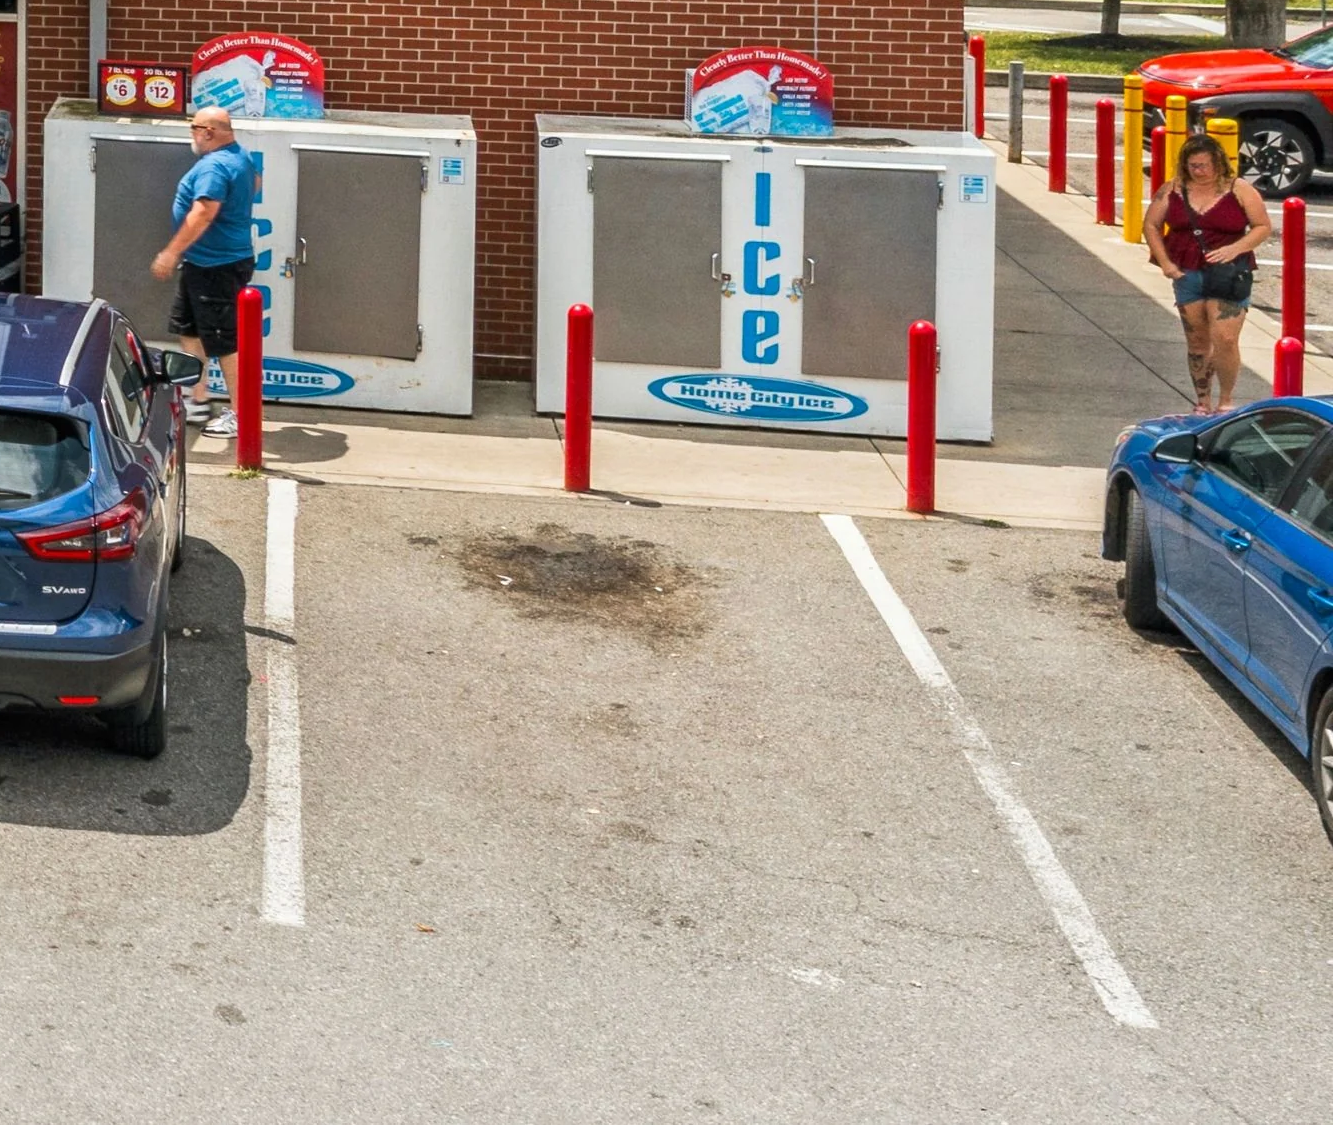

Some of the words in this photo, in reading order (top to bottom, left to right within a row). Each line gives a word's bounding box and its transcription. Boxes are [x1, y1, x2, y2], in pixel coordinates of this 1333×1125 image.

[198, 43, 224, 60] Clearly
[224, 38, 249, 47] Better
[249, 36, 270, 44] Than
[699, 58, 727, 77] Clearly
[727, 53, 753, 62] Better
[754, 50, 776, 59] Than
[113, 84, 127, 96] $6
[149, 86, 169, 99] $12
[290, 374, 324, 385] Ice
[679, 385, 746, 401] Home
[751, 393, 795, 407] City
[798, 395, 835, 409] Ice
